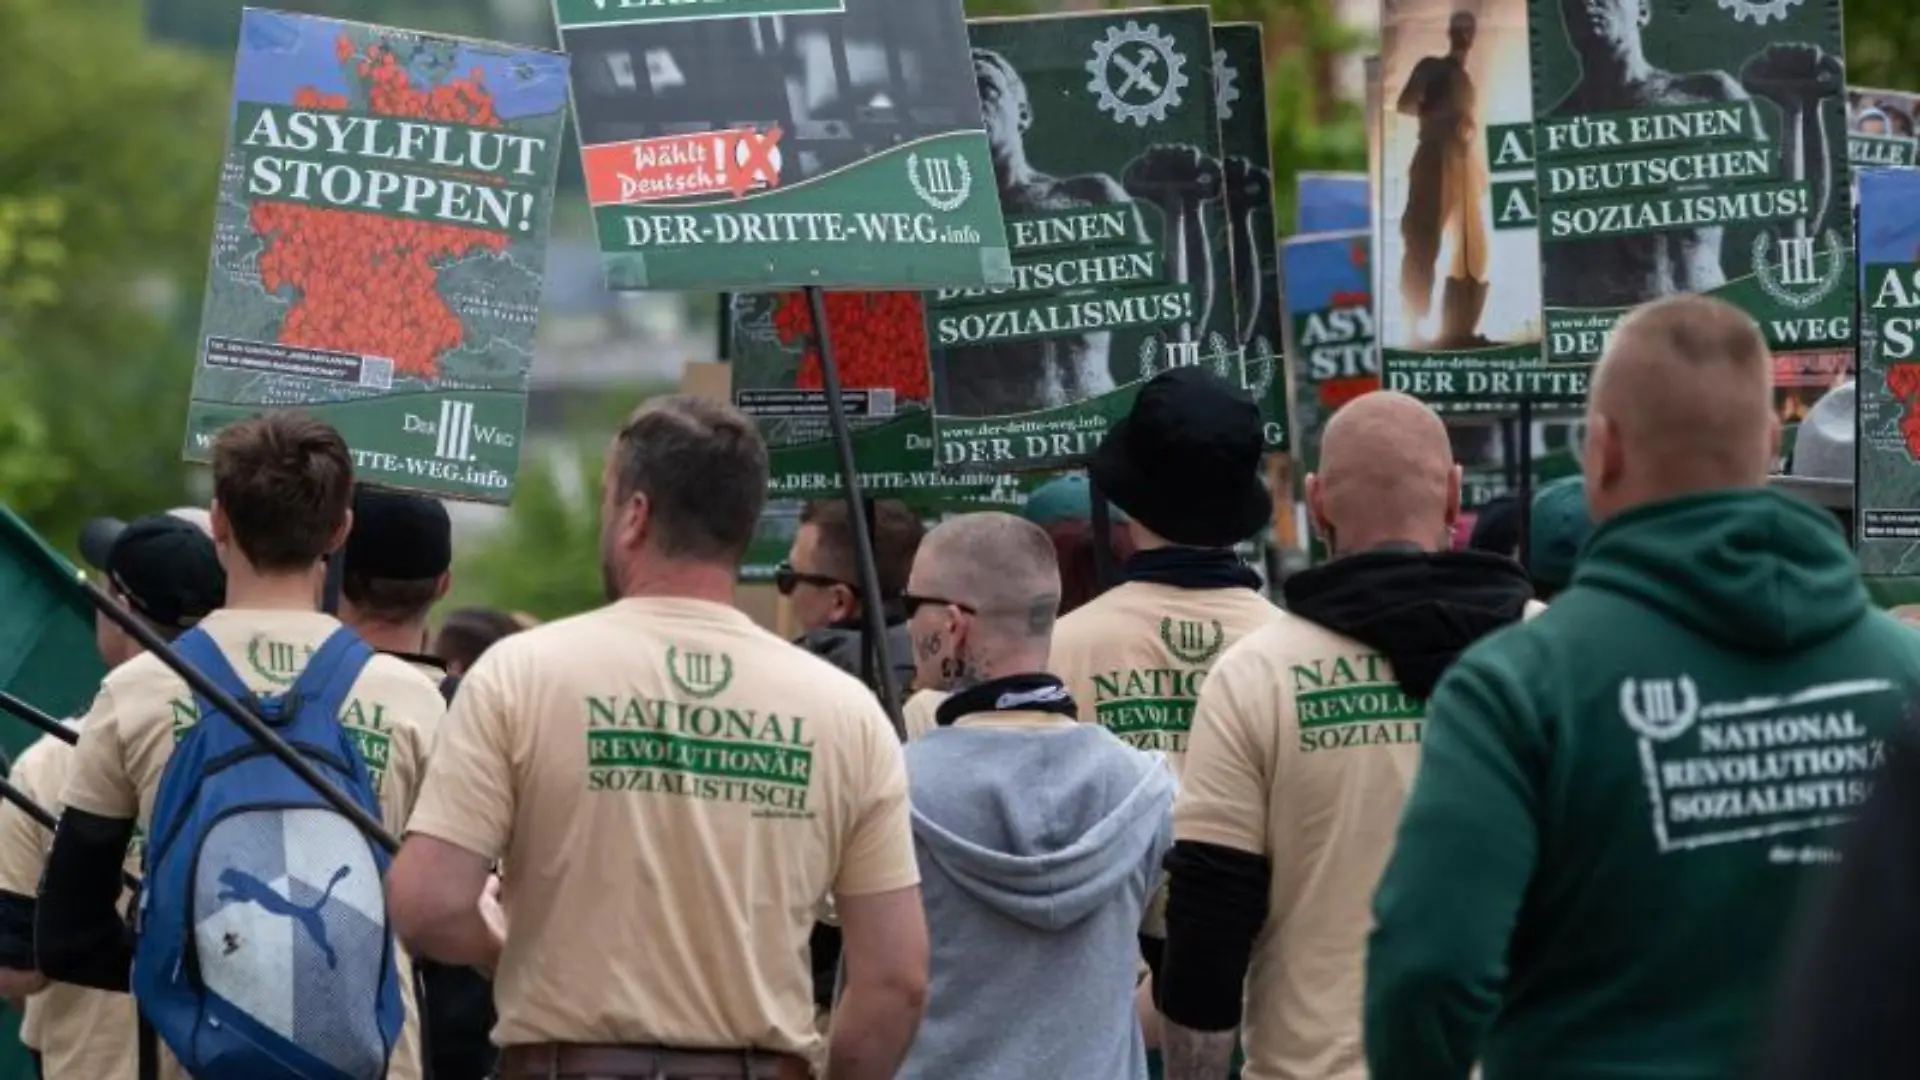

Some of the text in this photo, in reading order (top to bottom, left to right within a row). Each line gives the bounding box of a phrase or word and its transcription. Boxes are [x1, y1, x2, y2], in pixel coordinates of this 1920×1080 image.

[245, 108, 544, 176] ASYLFLUT
[1546, 107, 1743, 150] FÜR EINEN
[633, 143, 707, 172] Wählt
[1548, 148, 1771, 193] DEUTSCHEN
[249, 155, 533, 231] STOPPEN!
[1551, 188, 1809, 236] SOZIALISMUS!
[625, 212, 980, 247] DER-DRITTE-WEG.info
[1013, 211, 1127, 247] EINEN
[938, 292, 1193, 345] SOZIALISMUS!
[1772, 316, 1851, 344] WEG
[1389, 370, 1588, 394] DER DRITTE
[351, 448, 508, 488] TTE-WEG.info
[944, 437, 1016, 465] DER
[587, 695, 815, 747] NATIONAL
[1699, 711, 1866, 751] NATIONAL
[590, 736, 809, 779] REVOLUTIONÄR
[588, 768, 808, 811] SOZIALISTISCH
